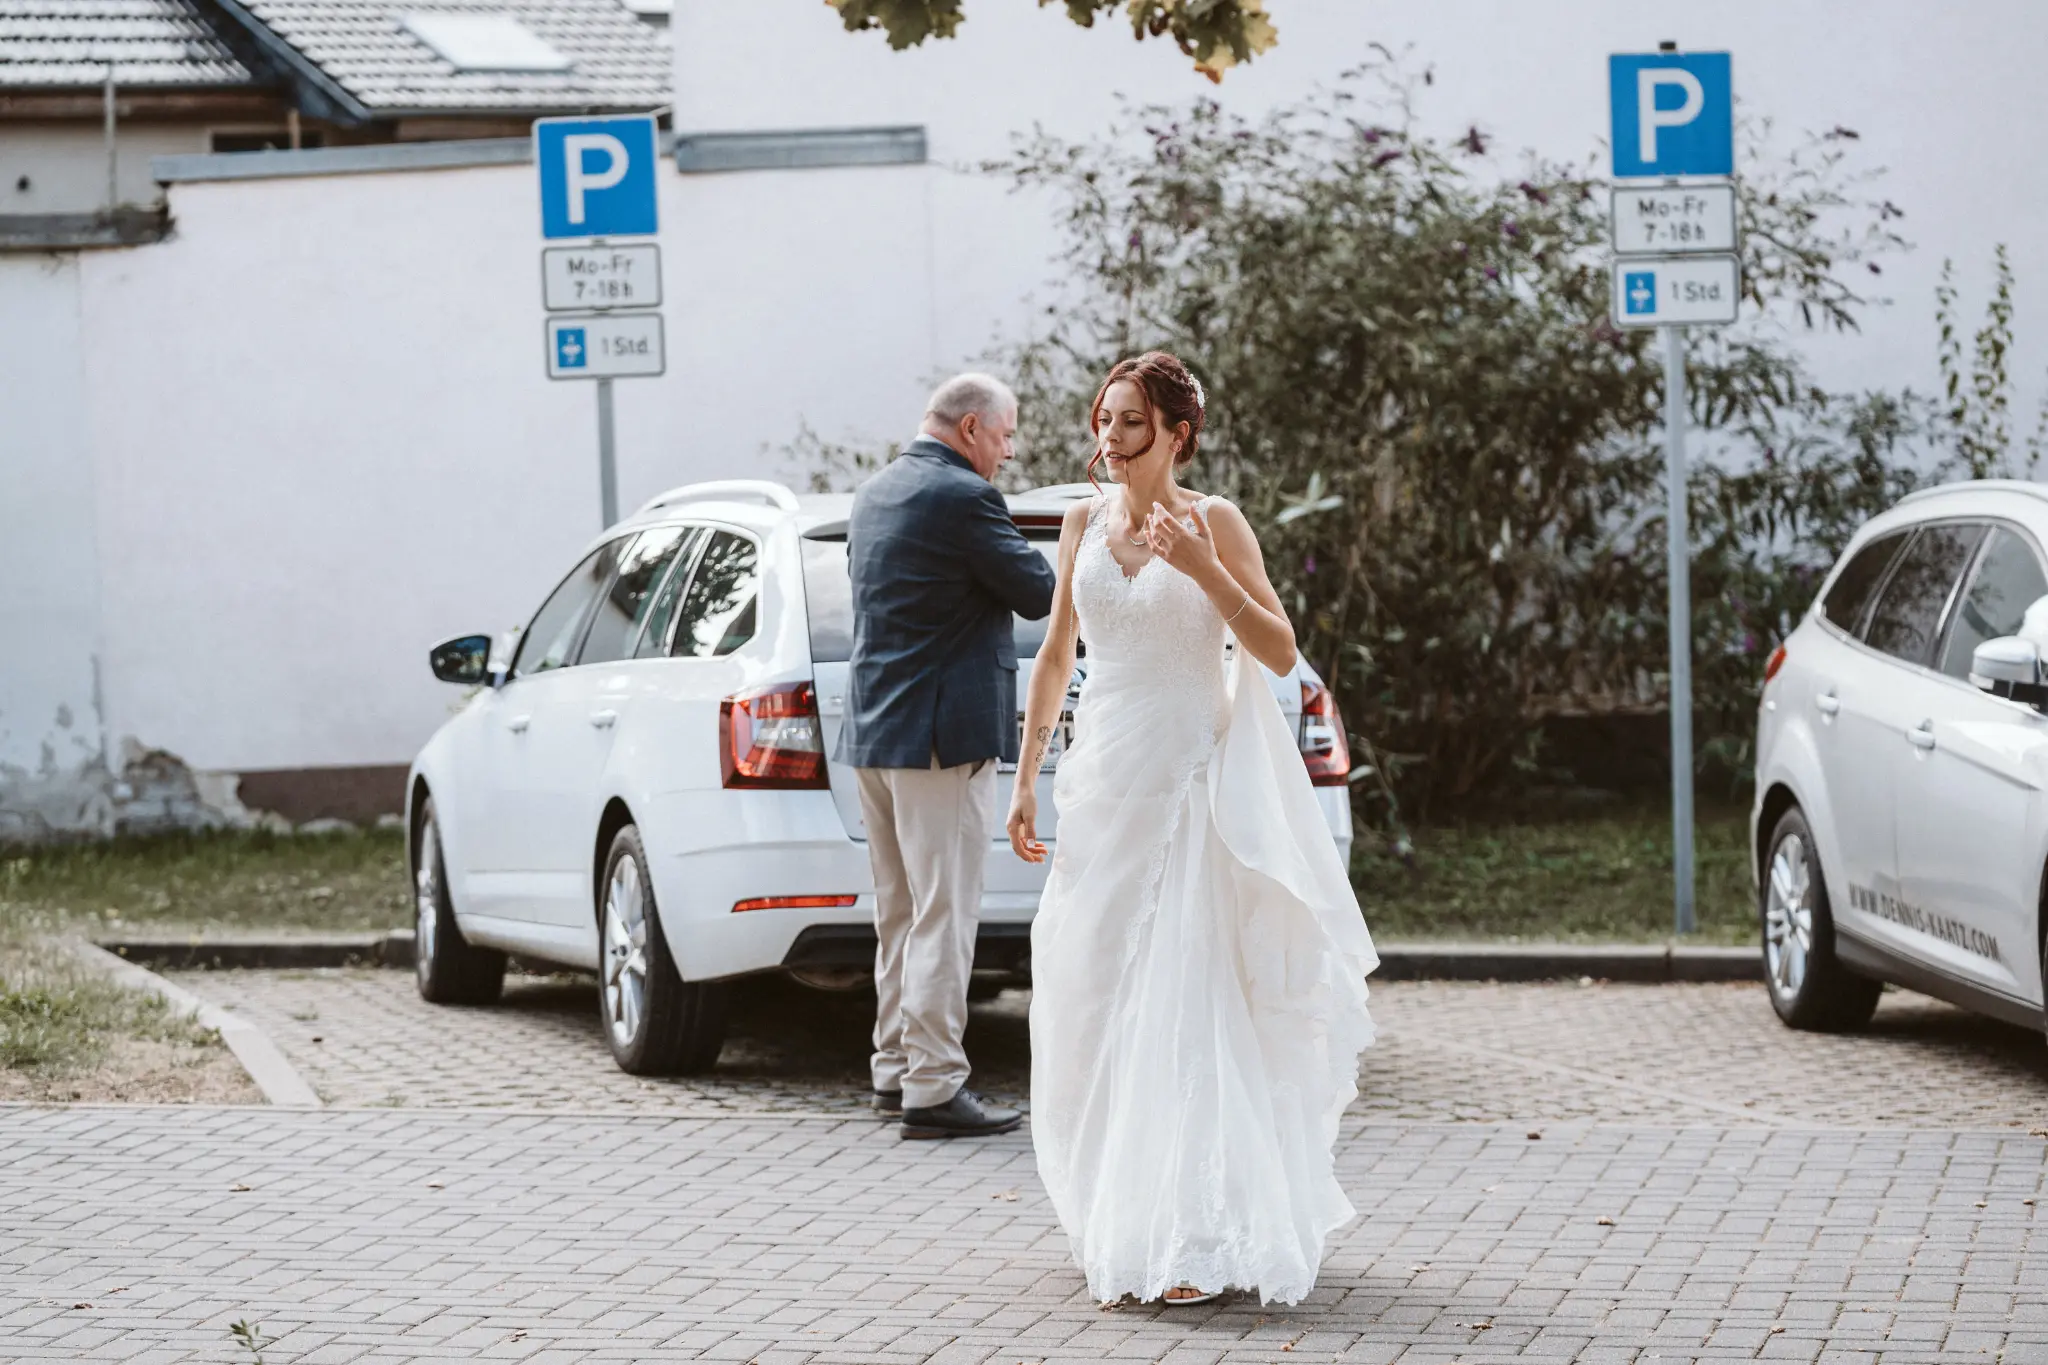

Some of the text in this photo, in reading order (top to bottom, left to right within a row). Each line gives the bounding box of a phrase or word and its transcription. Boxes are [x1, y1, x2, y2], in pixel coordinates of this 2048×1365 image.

[1636, 66, 1705, 164] P
[563, 132, 630, 225] P
[1636, 194, 1707, 218] Mo-Fr
[565, 253, 634, 275] Mo-Fr
